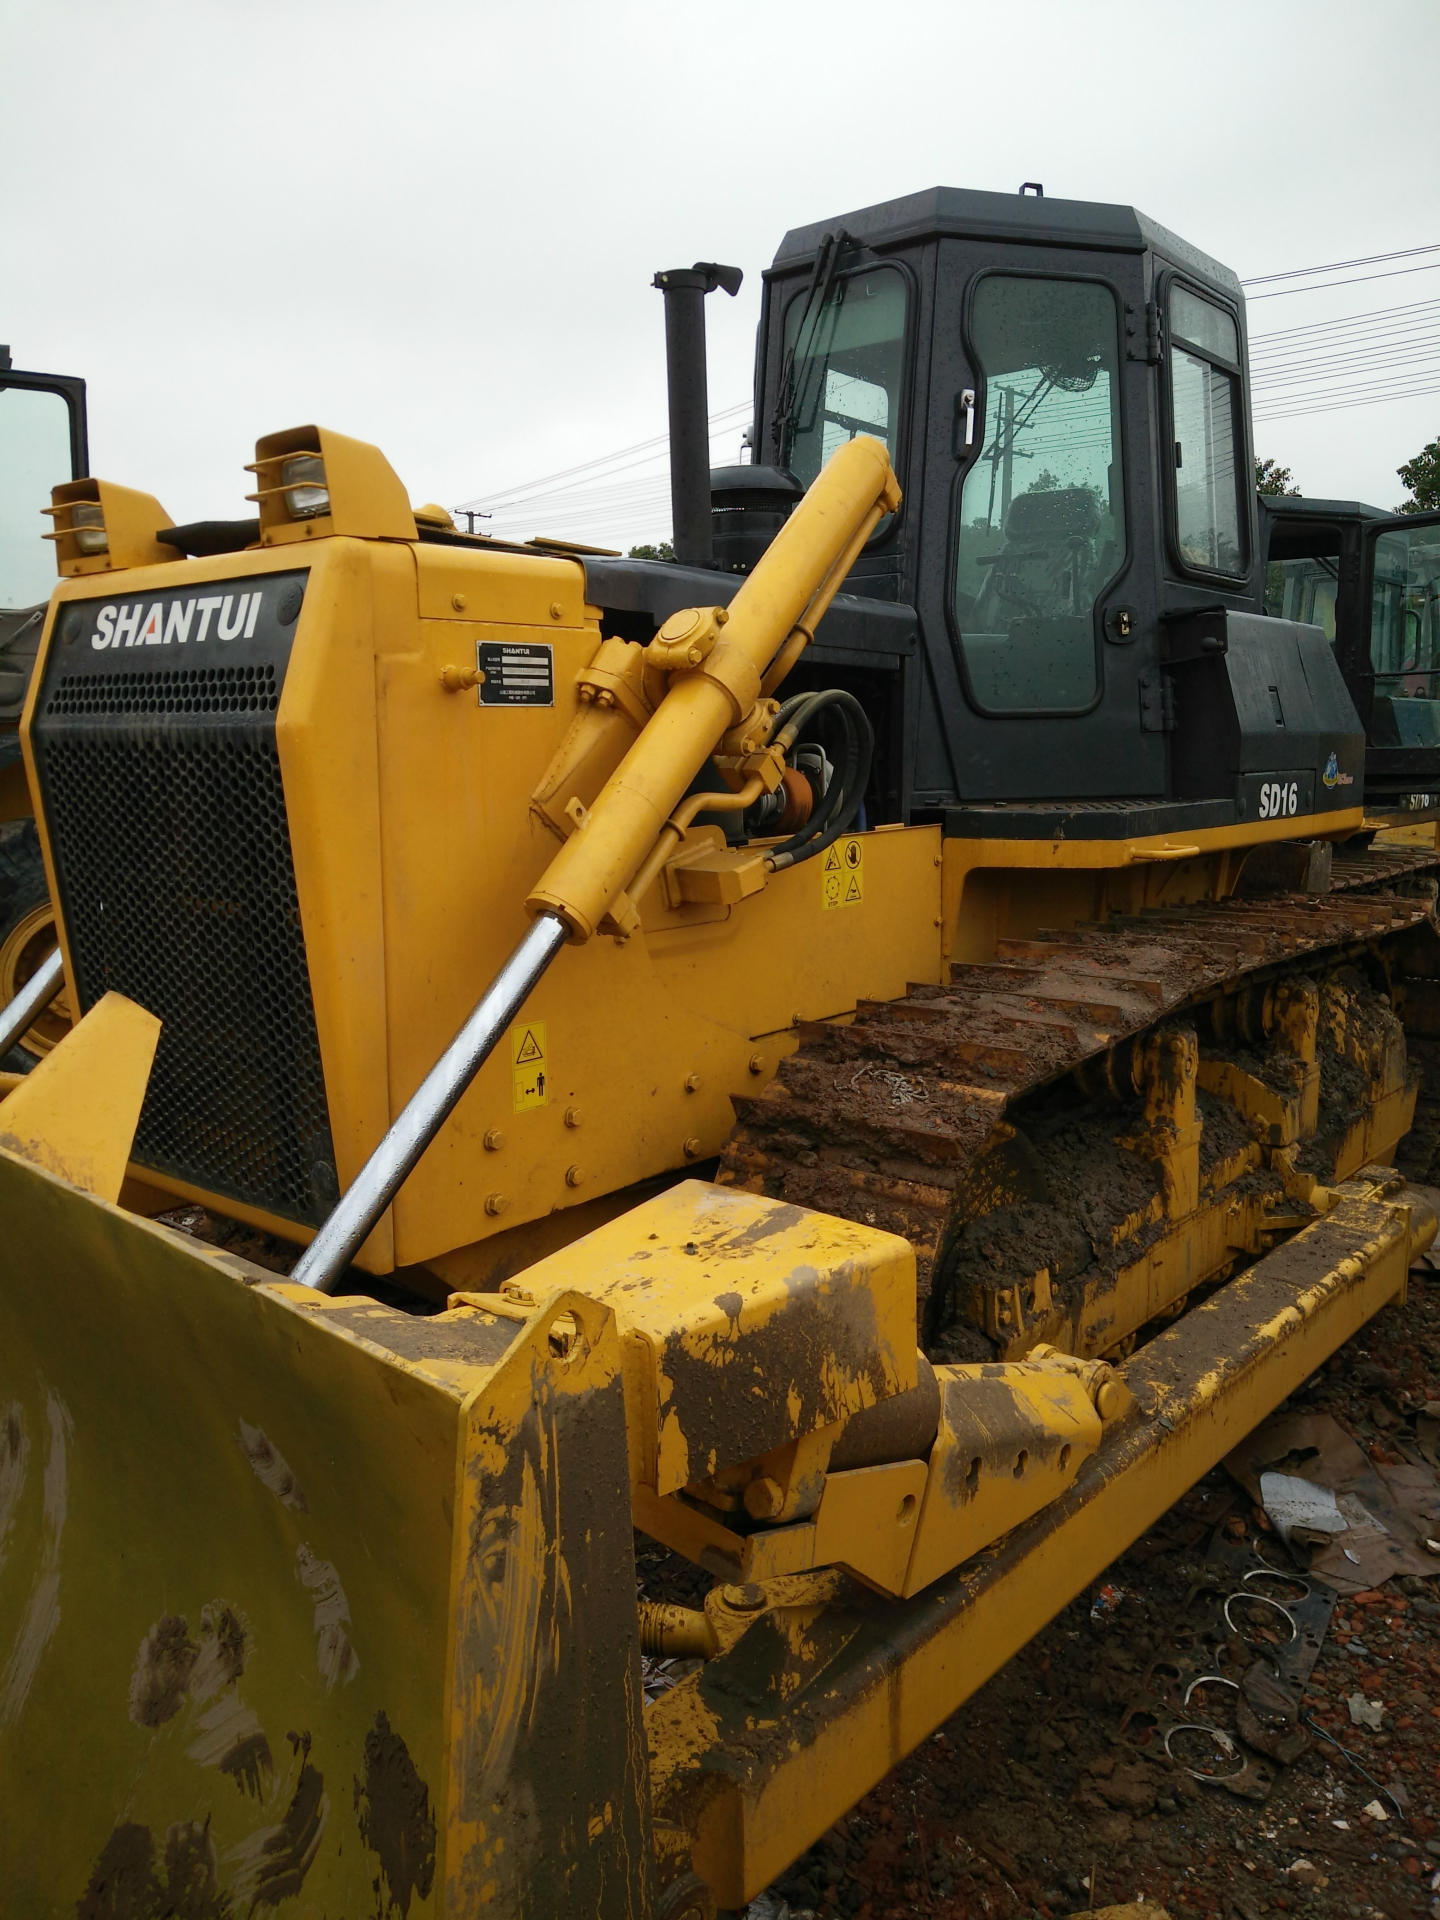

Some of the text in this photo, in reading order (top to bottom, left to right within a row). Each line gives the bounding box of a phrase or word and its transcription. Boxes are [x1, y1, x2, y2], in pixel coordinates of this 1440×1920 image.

[91, 592, 262, 650] SHANTUI
[502, 647, 530, 655] SHANTUI
[1258, 782, 1298, 819] SD16
